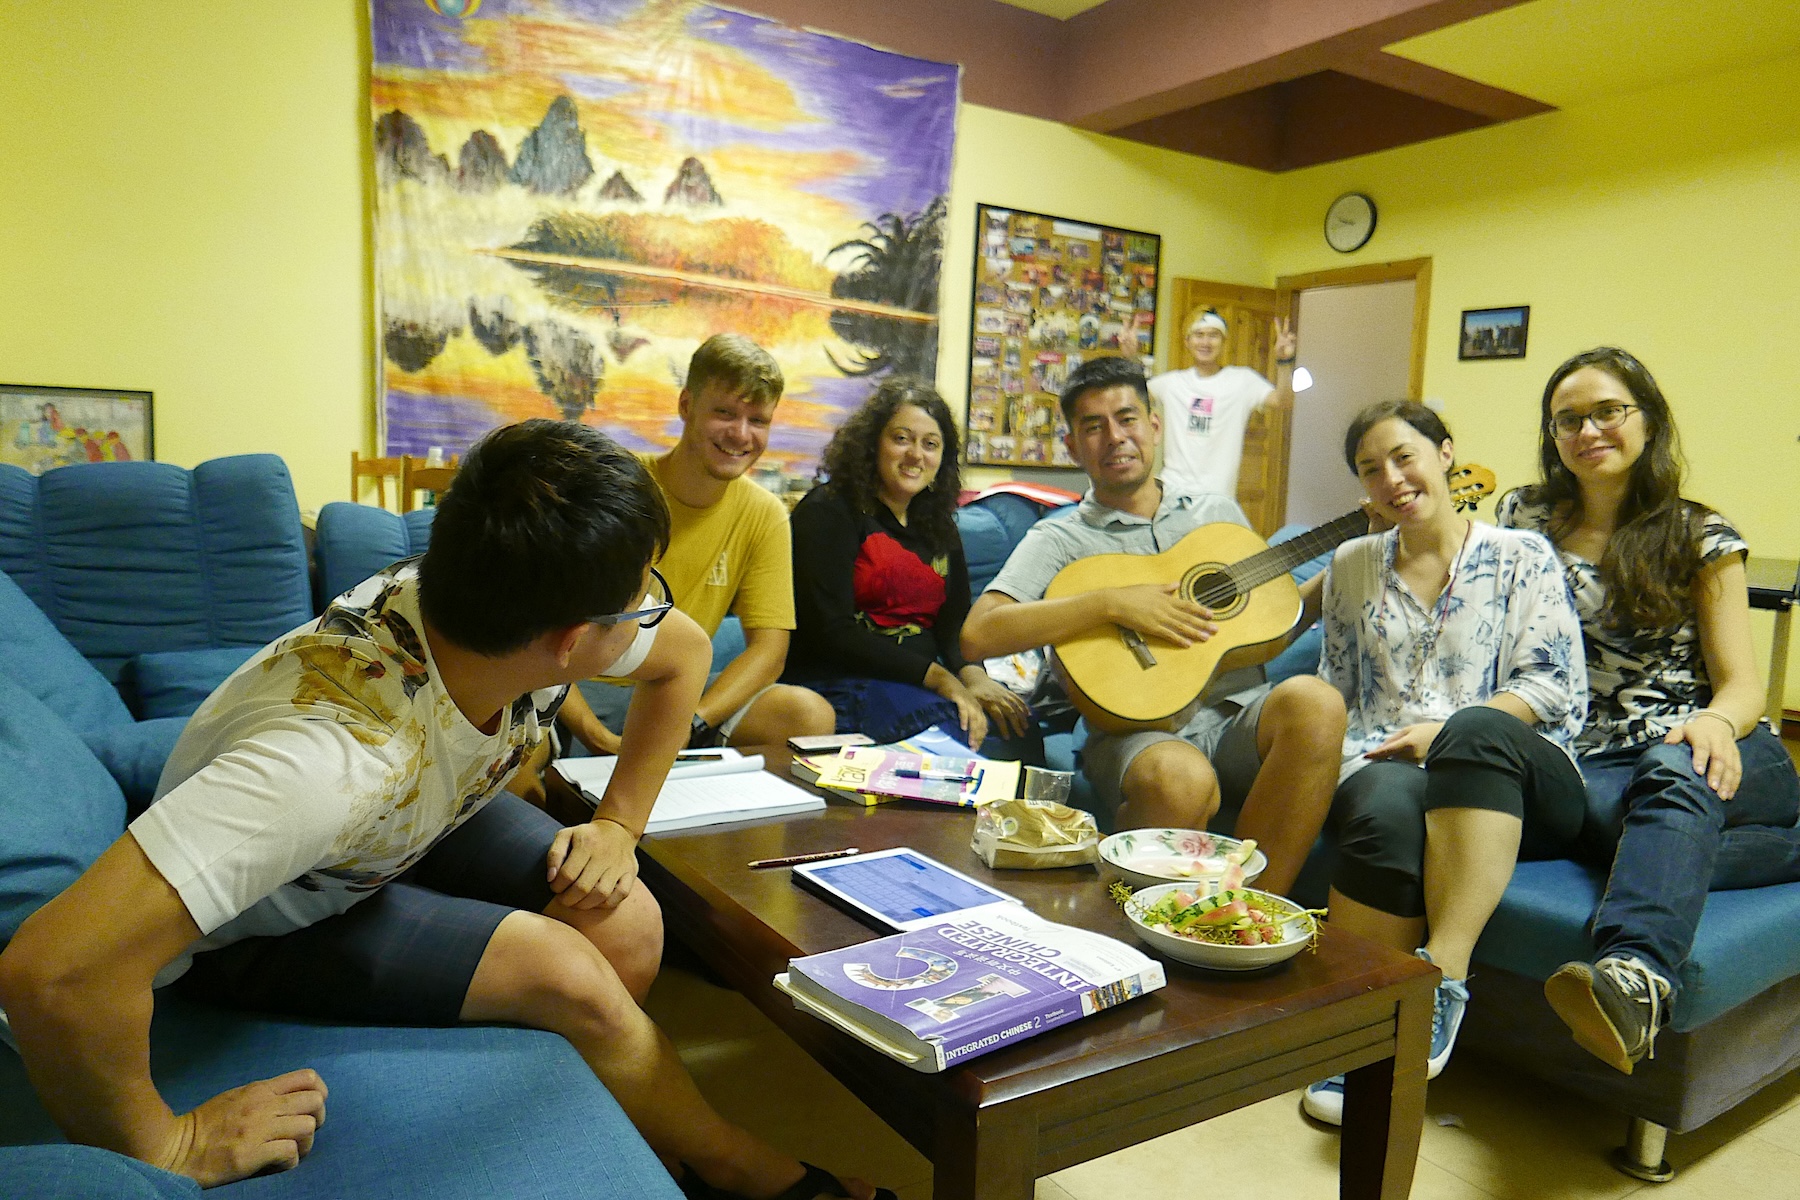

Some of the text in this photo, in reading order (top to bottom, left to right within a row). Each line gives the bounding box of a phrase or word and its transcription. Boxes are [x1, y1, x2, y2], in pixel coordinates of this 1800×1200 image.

[937, 927, 1090, 992] INTEGRATED
[958, 920, 1062, 958] CHINESE
[945, 1033, 1000, 1061] INTEGRATED
[1000, 1021, 1033, 1040] CHINESE
[1033, 1016, 1041, 1029] 2
